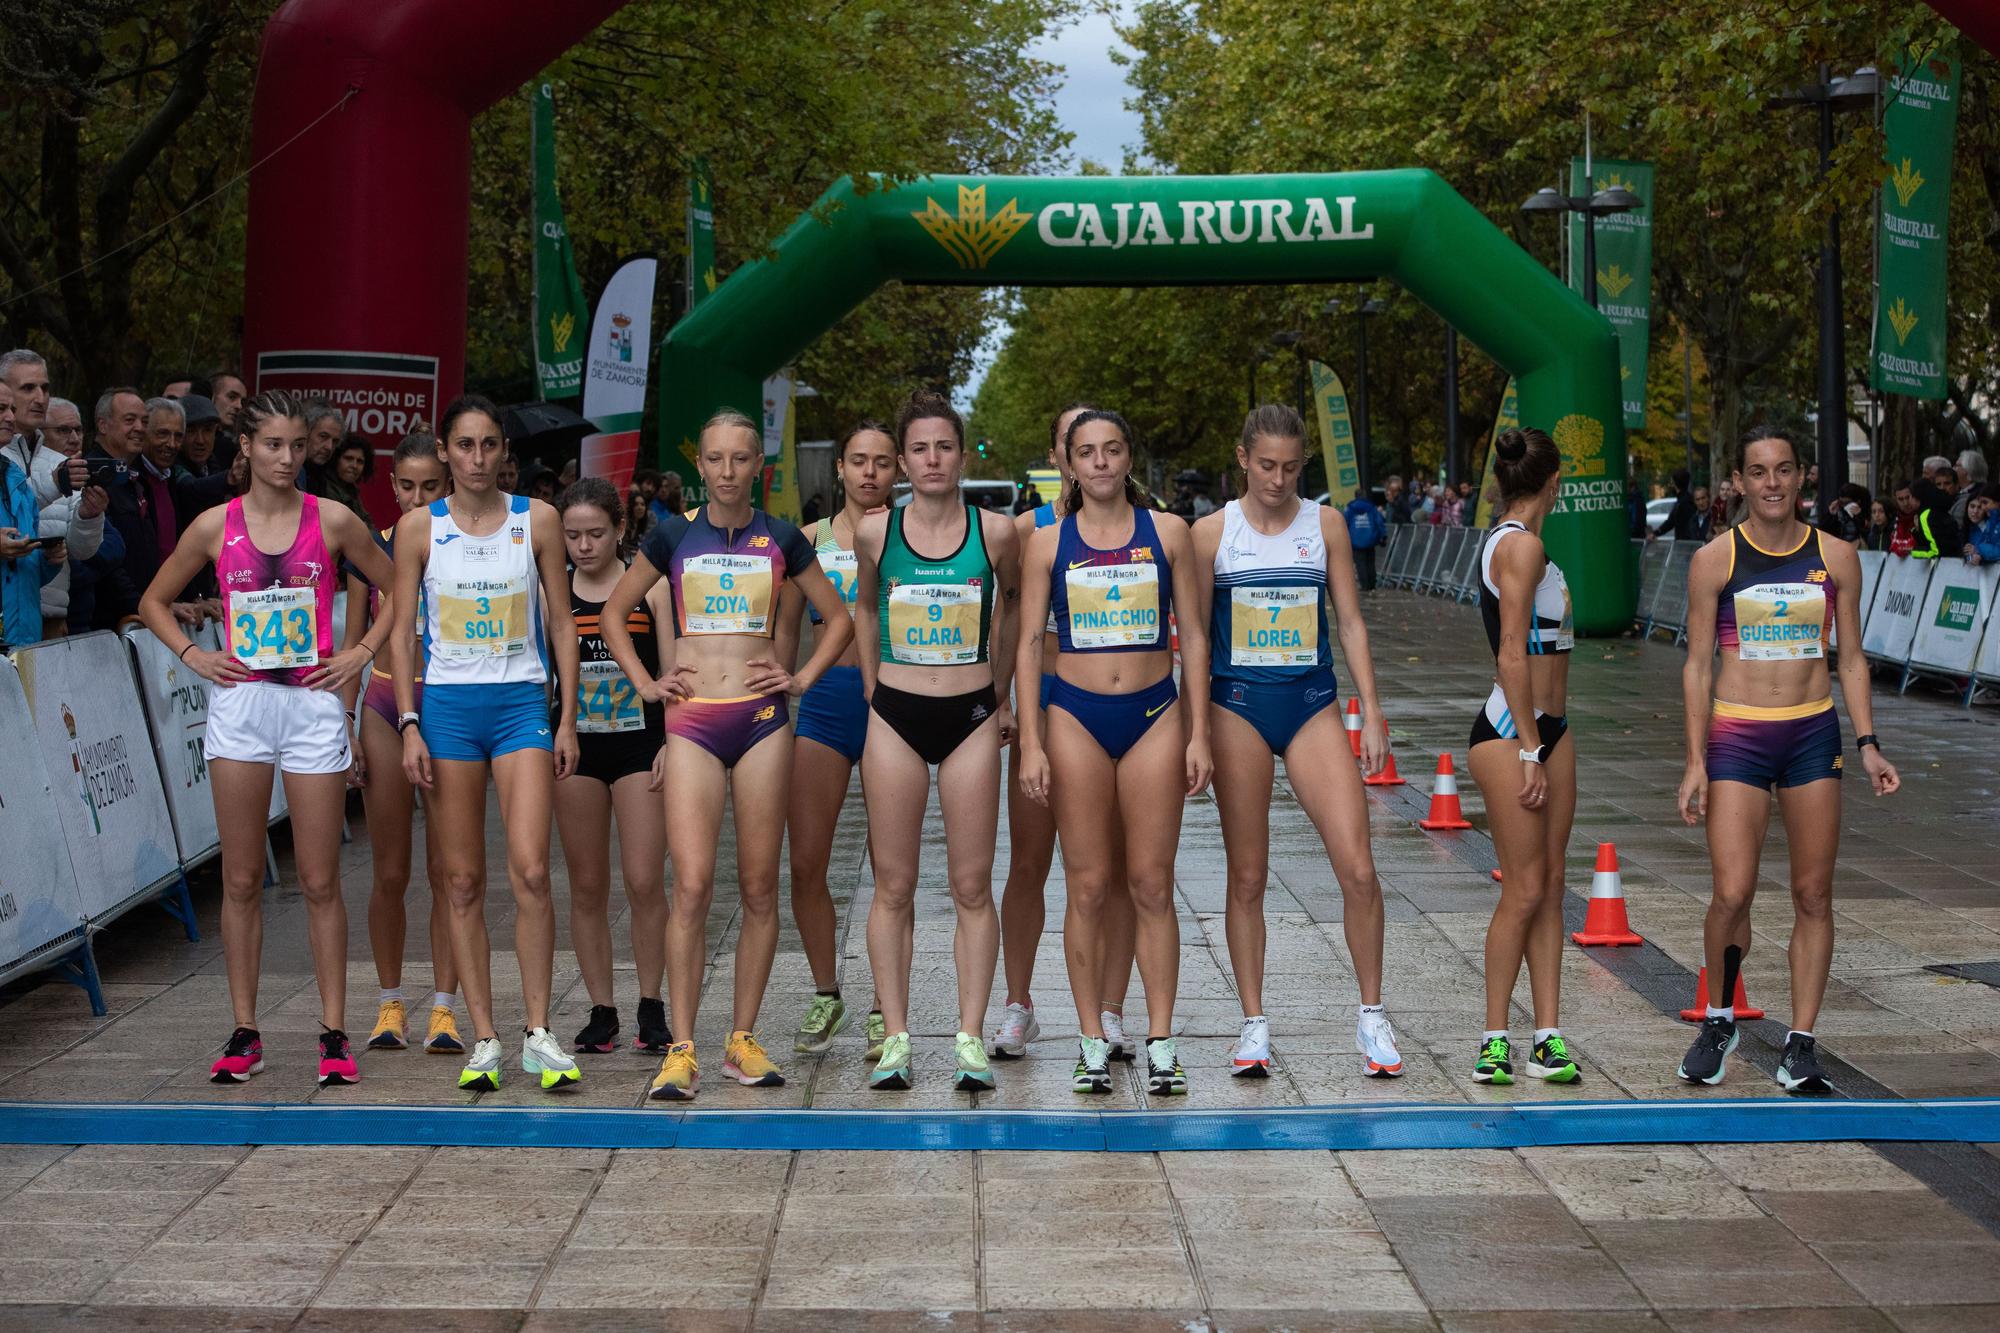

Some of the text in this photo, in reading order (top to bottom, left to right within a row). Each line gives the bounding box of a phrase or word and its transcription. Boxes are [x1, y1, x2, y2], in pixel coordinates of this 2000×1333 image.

[1037, 196, 1375, 250] CAJA RURAL
[1609, 212, 1650, 226] RURAL
[1897, 218, 1940, 240] RURAL
[1895, 357, 1941, 377] RURAL
[404, 393, 426, 409] DE
[1574, 495, 1624, 512] RURAL
[719, 572, 735, 591] 6
[1105, 585, 1121, 602] 4
[475, 597, 491, 615] 3
[704, 596, 749, 615] ZOYA
[928, 603, 943, 622] 9
[1267, 606, 1281, 624] 7
[1774, 600, 1788, 618] 2
[1073, 608, 1157, 630] PINACCHIO
[235, 607, 313, 658] 343
[465, 620, 504, 639] SOLI
[906, 627, 963, 646] CLARA
[1248, 629, 1301, 648] LOREA
[1740, 623, 1820, 642] GUERRERO
